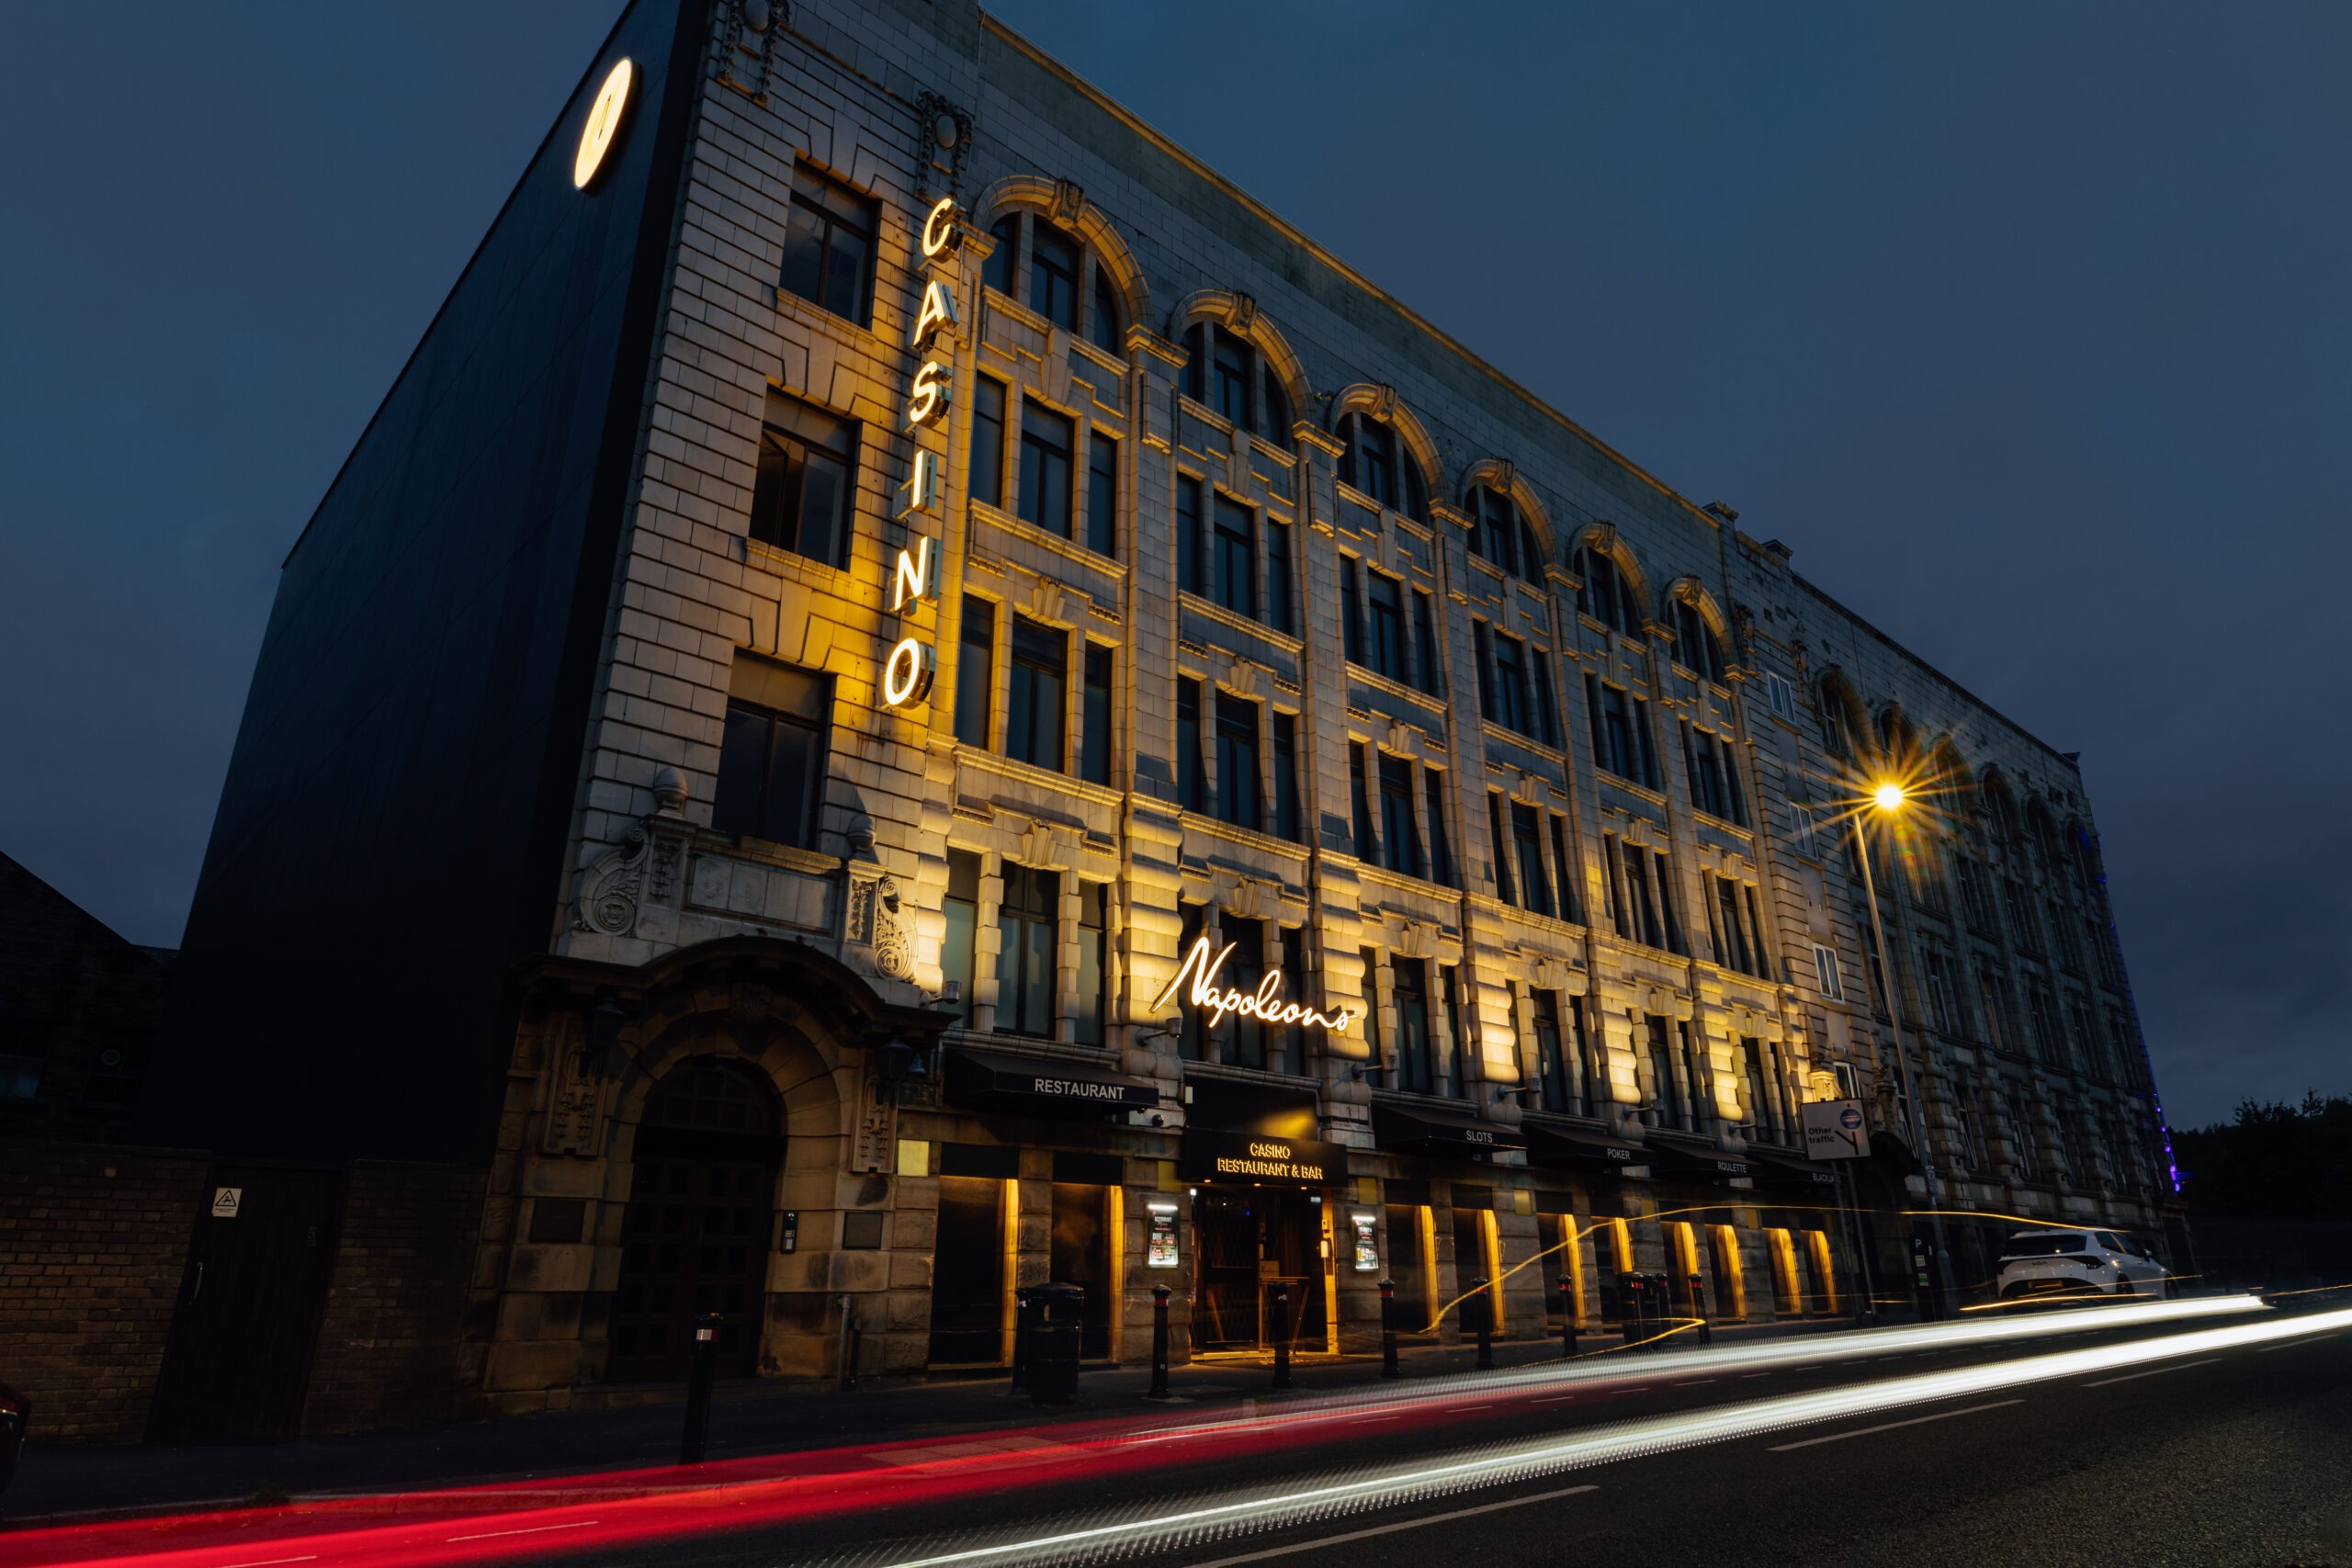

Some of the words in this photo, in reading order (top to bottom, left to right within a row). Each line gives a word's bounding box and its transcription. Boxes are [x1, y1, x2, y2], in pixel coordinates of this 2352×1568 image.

[884, 197, 957, 707] CASINO
[1149, 936, 1358, 1032] Napoleons
[1035, 1077, 1125, 1100] RESTAURANT
[1465, 1130, 1493, 1144] SLOTS
[1808, 1127, 1832, 1135] Other
[1809, 1135, 1835, 1145] traffic
[1250, 1142, 1291, 1159] CASINO
[1607, 1147, 1631, 1161] POKER
[1217, 1157, 1290, 1177] RESTAURANT
[1291, 1164, 1300, 1178] &
[1301, 1166, 1324, 1180] BAR
[1717, 1160, 1747, 1174] ROULETTE
[1915, 1238, 1922, 1249] P
